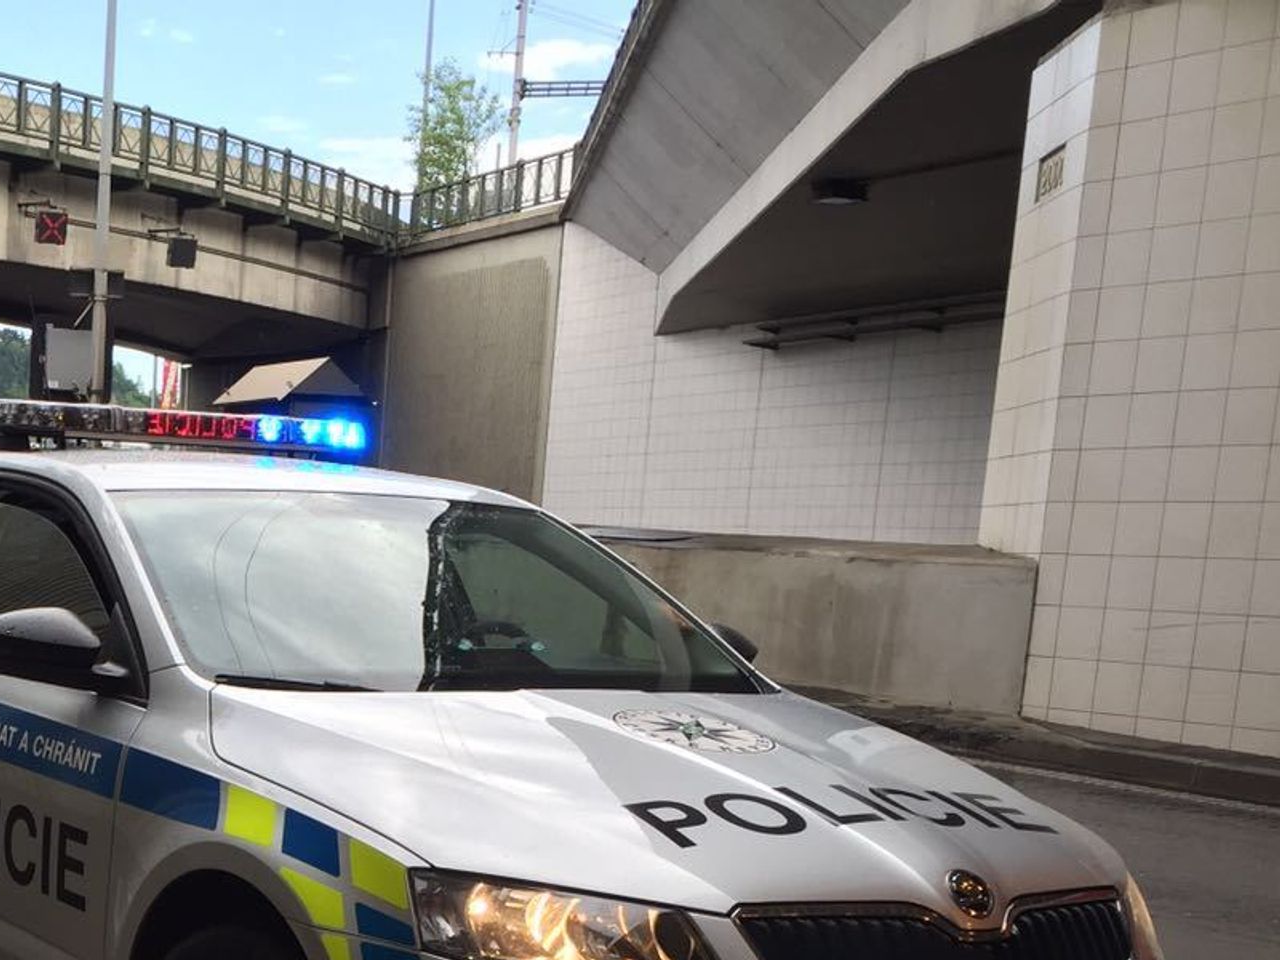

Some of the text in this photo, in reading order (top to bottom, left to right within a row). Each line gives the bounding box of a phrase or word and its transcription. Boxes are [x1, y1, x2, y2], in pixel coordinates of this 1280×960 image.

[18, 730, 29, 753] A
[33, 735, 101, 775] CHRÁNIT
[622, 784, 1060, 849] POLICIE
